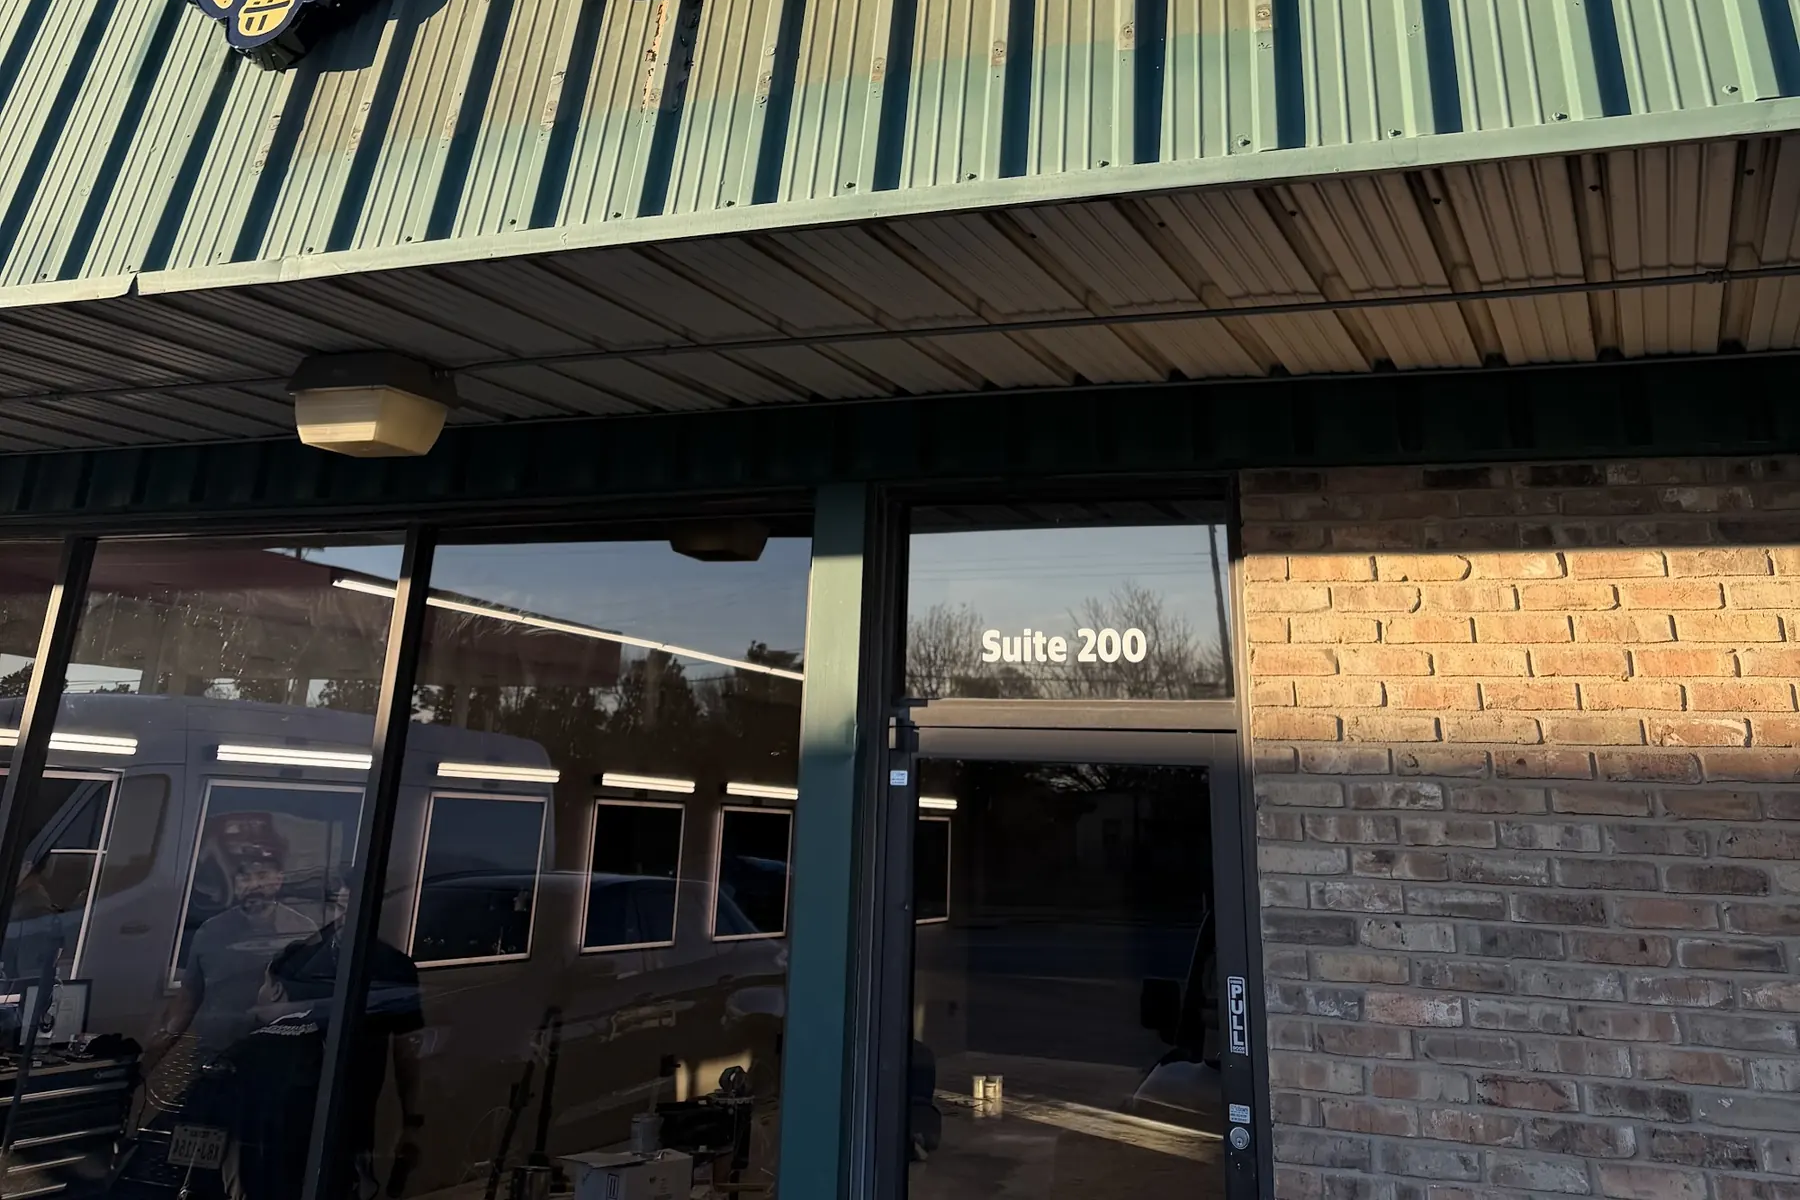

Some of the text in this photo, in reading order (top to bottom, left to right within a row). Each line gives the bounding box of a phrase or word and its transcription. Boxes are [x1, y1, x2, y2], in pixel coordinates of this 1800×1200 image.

[982, 628, 1147, 663] Suite 200
[1231, 984, 1244, 1046] PULL
